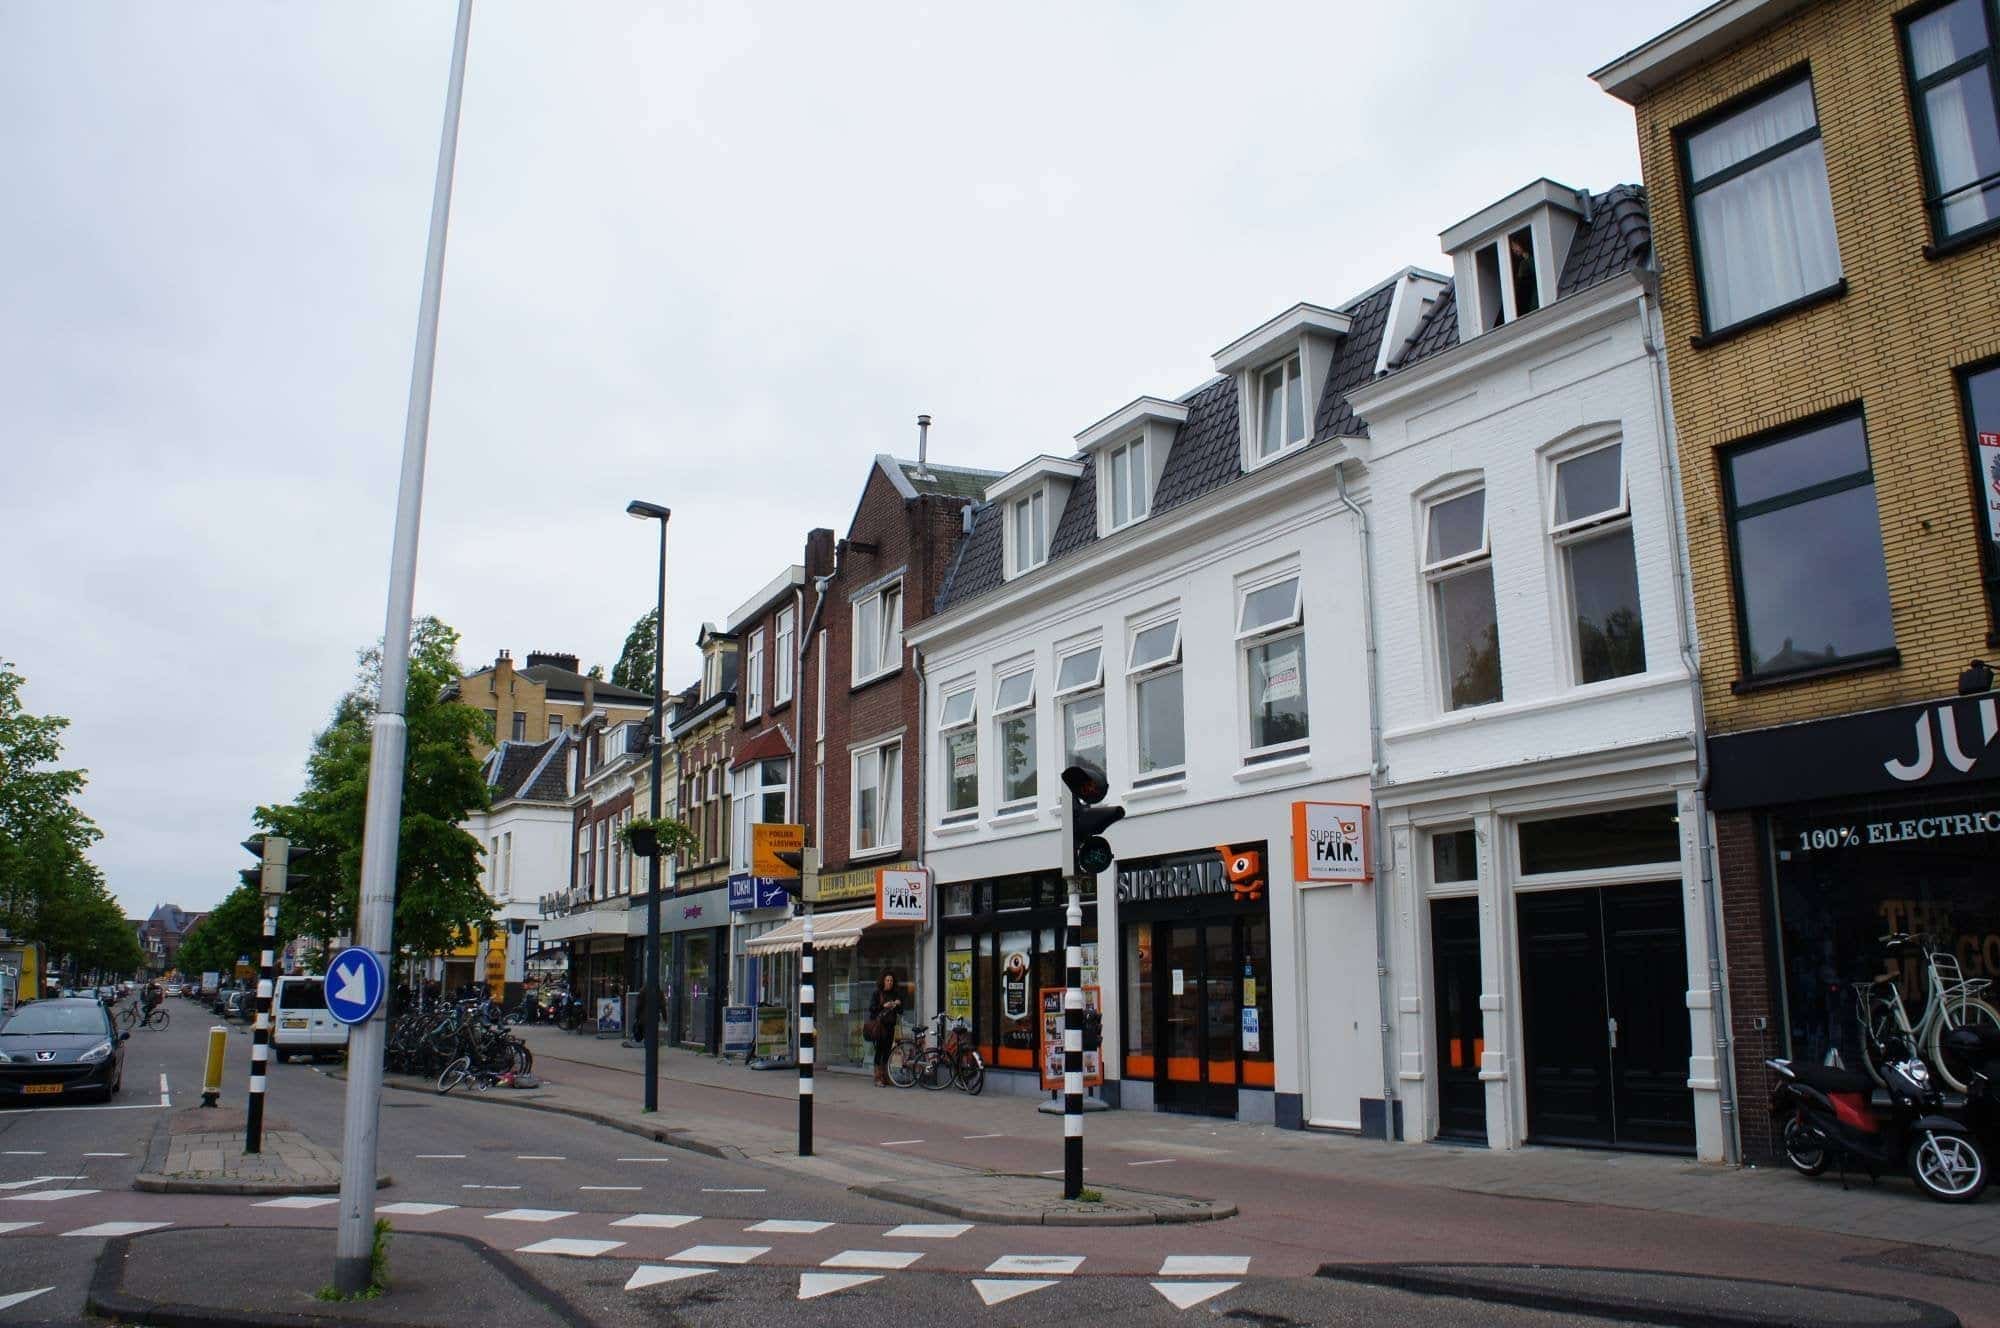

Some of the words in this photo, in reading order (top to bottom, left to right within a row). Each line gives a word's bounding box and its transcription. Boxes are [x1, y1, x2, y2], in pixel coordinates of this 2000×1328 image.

[1310, 829, 1342, 843] SUPER
[1799, 824, 1860, 852] 100%
[1866, 811, 2000, 845] ELECTRIC
[1316, 841, 1359, 863] FAIR.
[885, 887, 911, 897] SUPER
[889, 895, 922, 909] FAIR.
